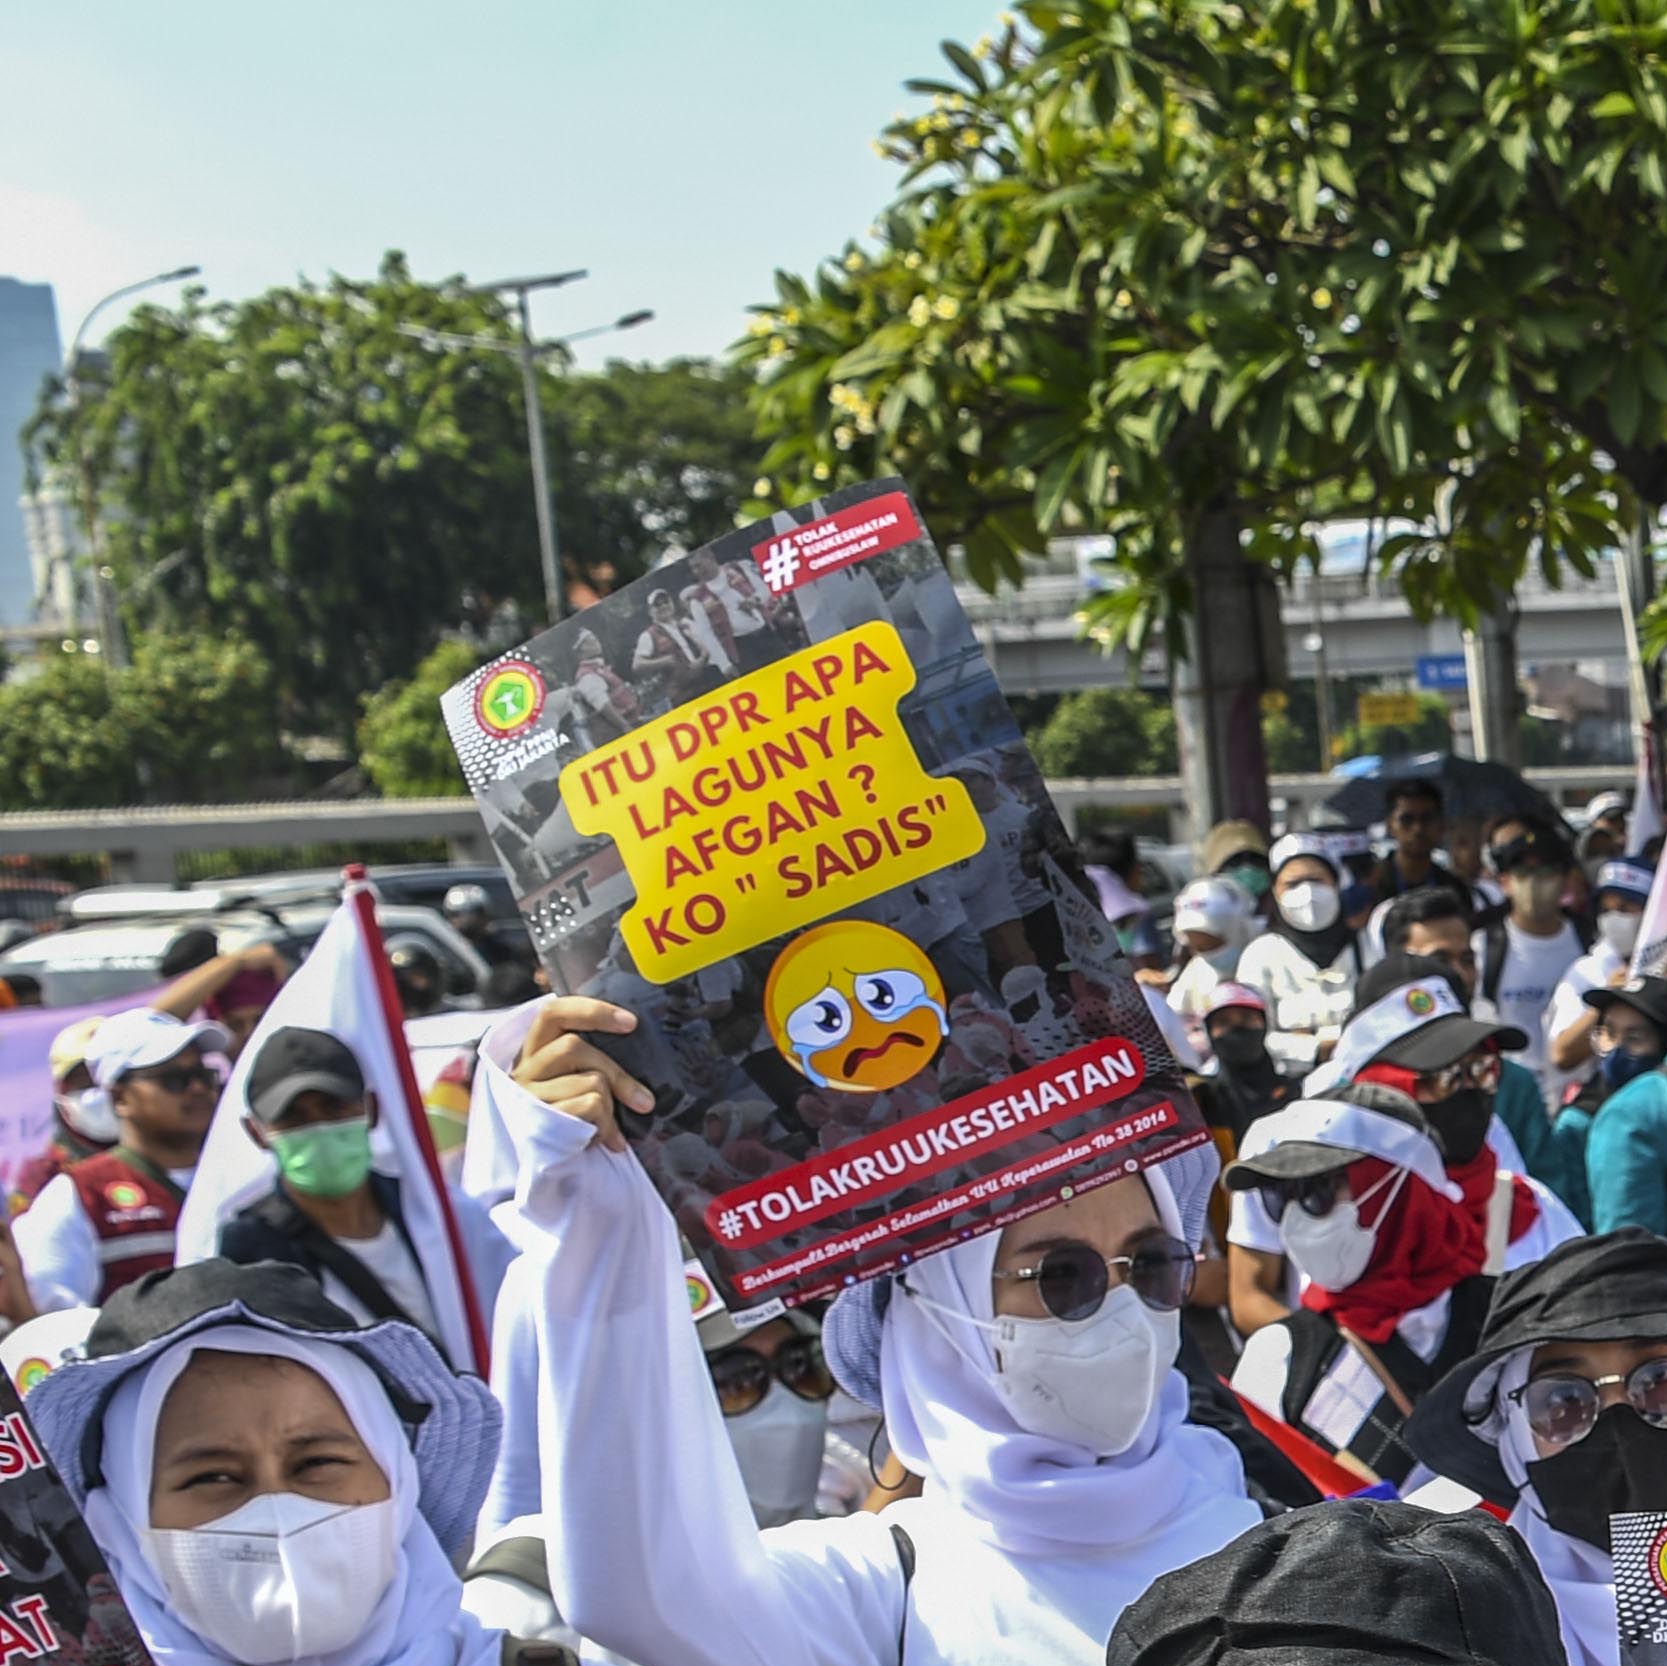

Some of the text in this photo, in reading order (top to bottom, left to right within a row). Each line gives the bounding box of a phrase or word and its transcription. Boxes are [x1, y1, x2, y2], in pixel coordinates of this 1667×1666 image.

[794, 522, 838, 545] TOLAK
[579, 641, 891, 806] ITU DPR APA
[628, 706, 883, 840] LAGUNYA
[643, 795, 948, 955] KO SADIS"
[664, 764, 877, 888] AFGAN ?
[719, 1050, 1137, 1240] #TOLAKRUUKESEHATAN
[1134, 1109, 1168, 1133] 2014
